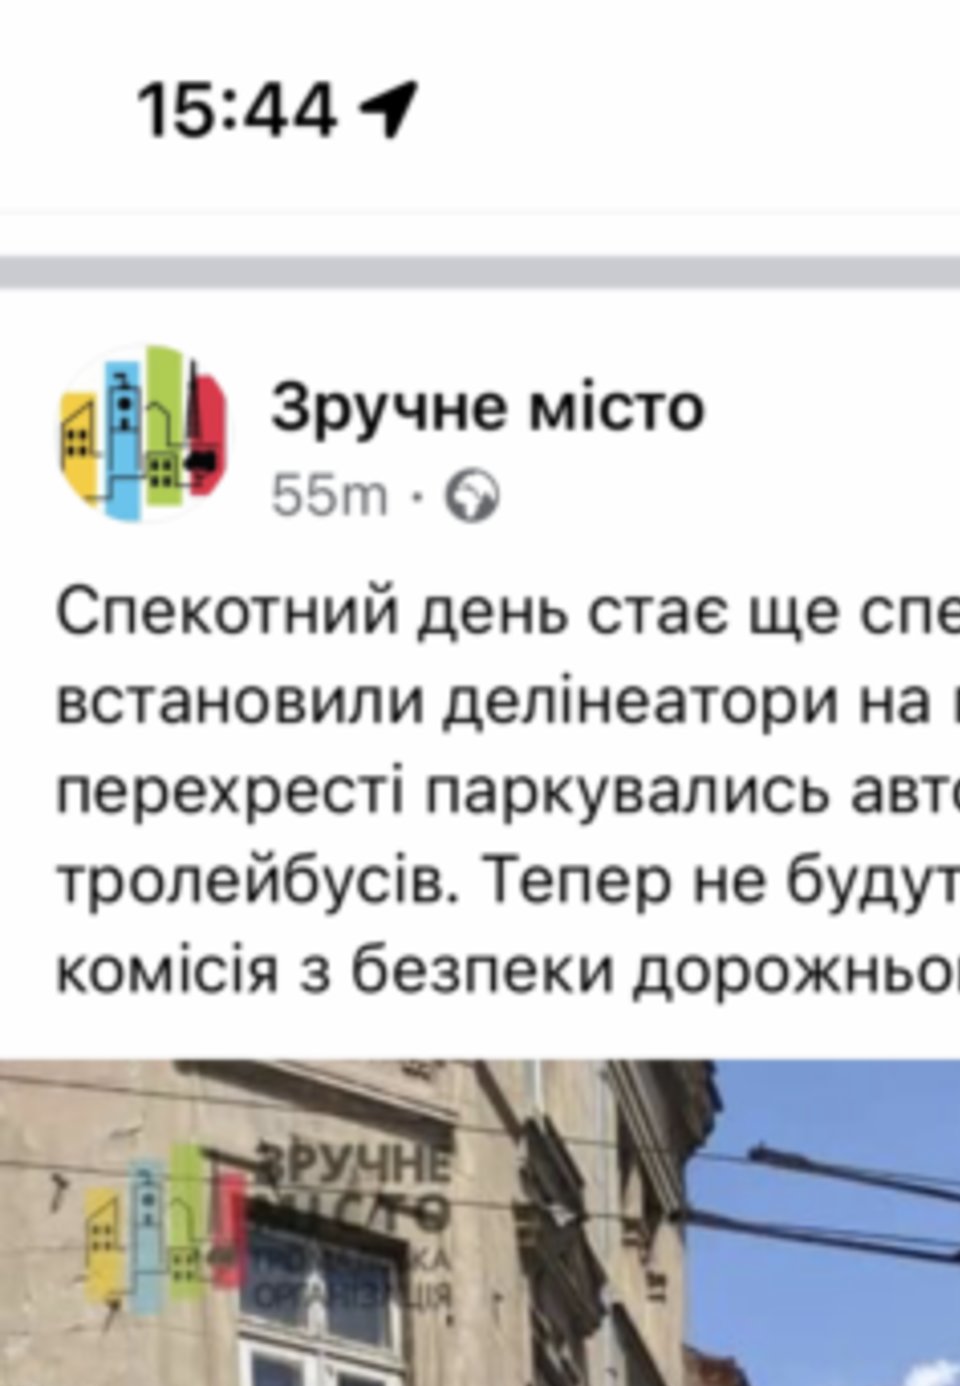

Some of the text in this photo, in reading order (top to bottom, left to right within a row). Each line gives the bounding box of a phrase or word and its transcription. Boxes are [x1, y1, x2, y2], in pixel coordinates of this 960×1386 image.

[138, 81, 338, 139] 15:44
[272, 377, 705, 443] Зручне місто
[274, 474, 386, 516] 55m
[57, 581, 397, 635] Спекотний
[417, 596, 568, 643] день
[588, 596, 728, 635] стає
[750, 596, 840, 643] ще
[58, 685, 423, 724] встановили
[442, 672, 837, 735] делінеатори
[861, 685, 930, 724] на
[58, 762, 402, 825] перехресті
[427, 775, 830, 826] паркувались
[56, 850, 458, 916] тролейбусів.
[481, 853, 671, 915] Тепер
[695, 864, 767, 904] не
[58, 941, 277, 994] комісія
[300, 954, 330, 994] з
[352, 941, 613, 994] безпеки
